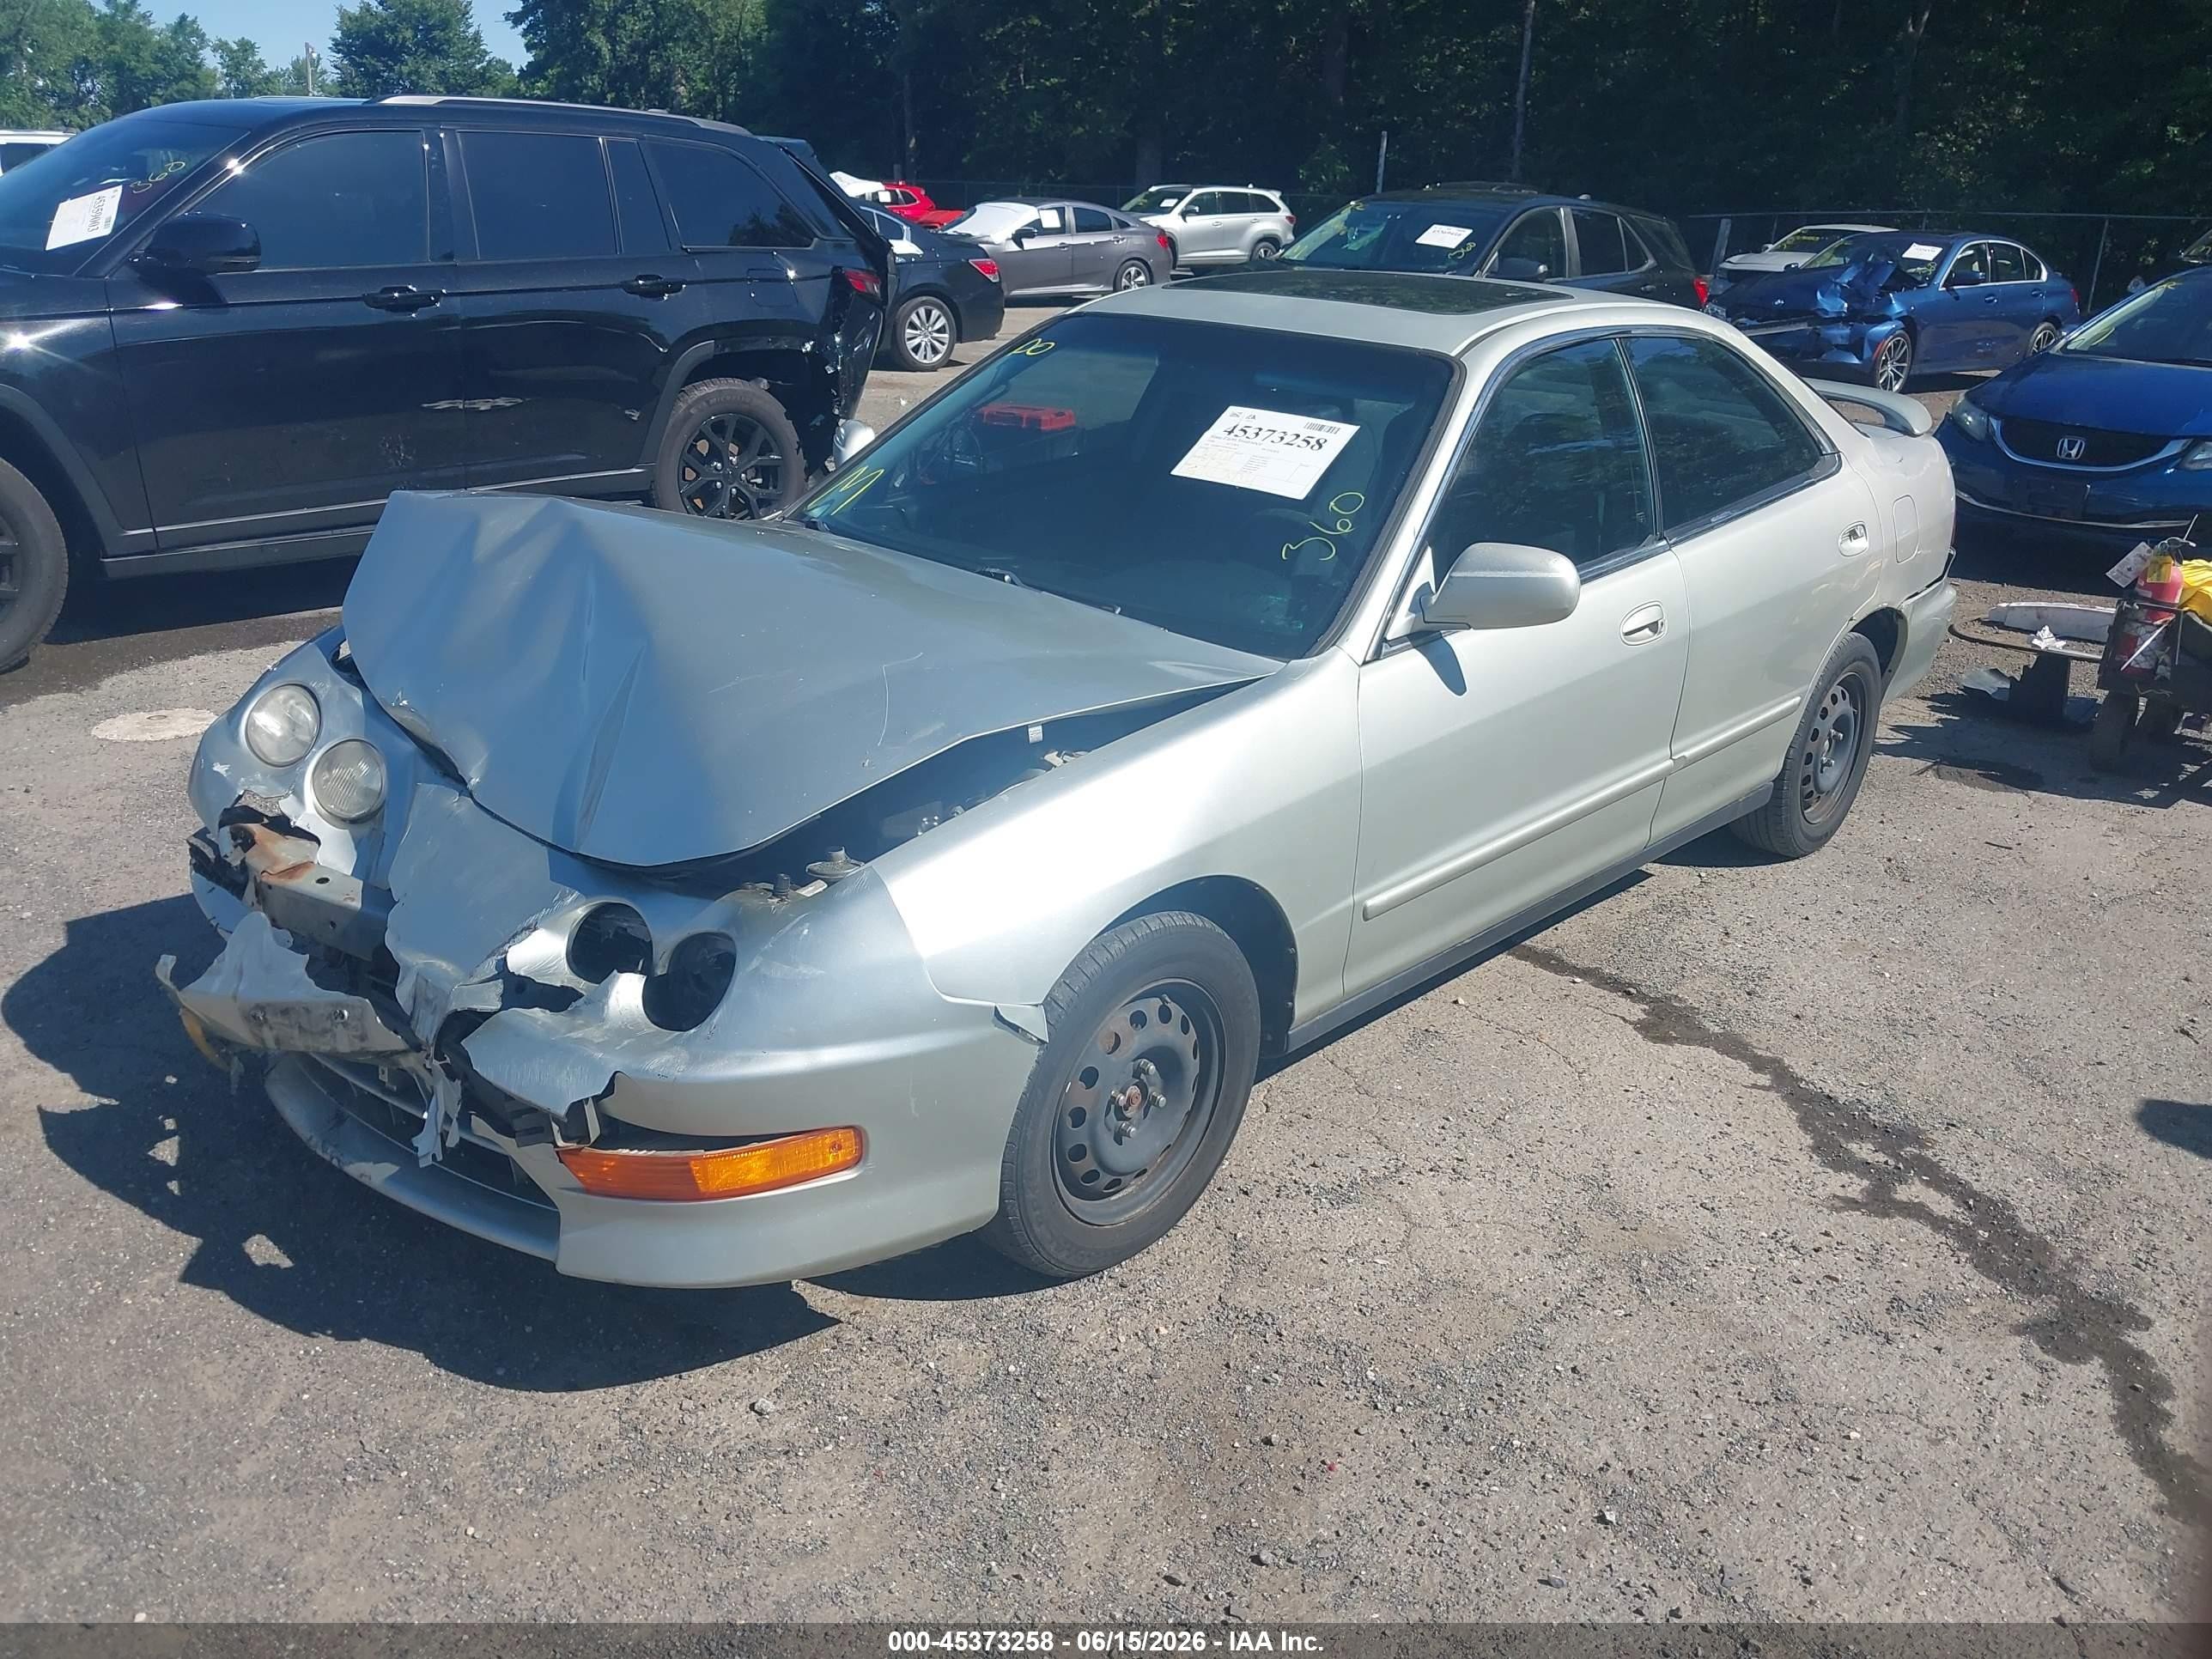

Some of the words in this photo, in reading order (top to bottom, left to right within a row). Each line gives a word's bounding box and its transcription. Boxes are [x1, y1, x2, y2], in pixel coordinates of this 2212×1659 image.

[130, 161, 186, 194] 360
[1222, 423, 1328, 451] 45373258
[1281, 491, 1365, 562] 360
